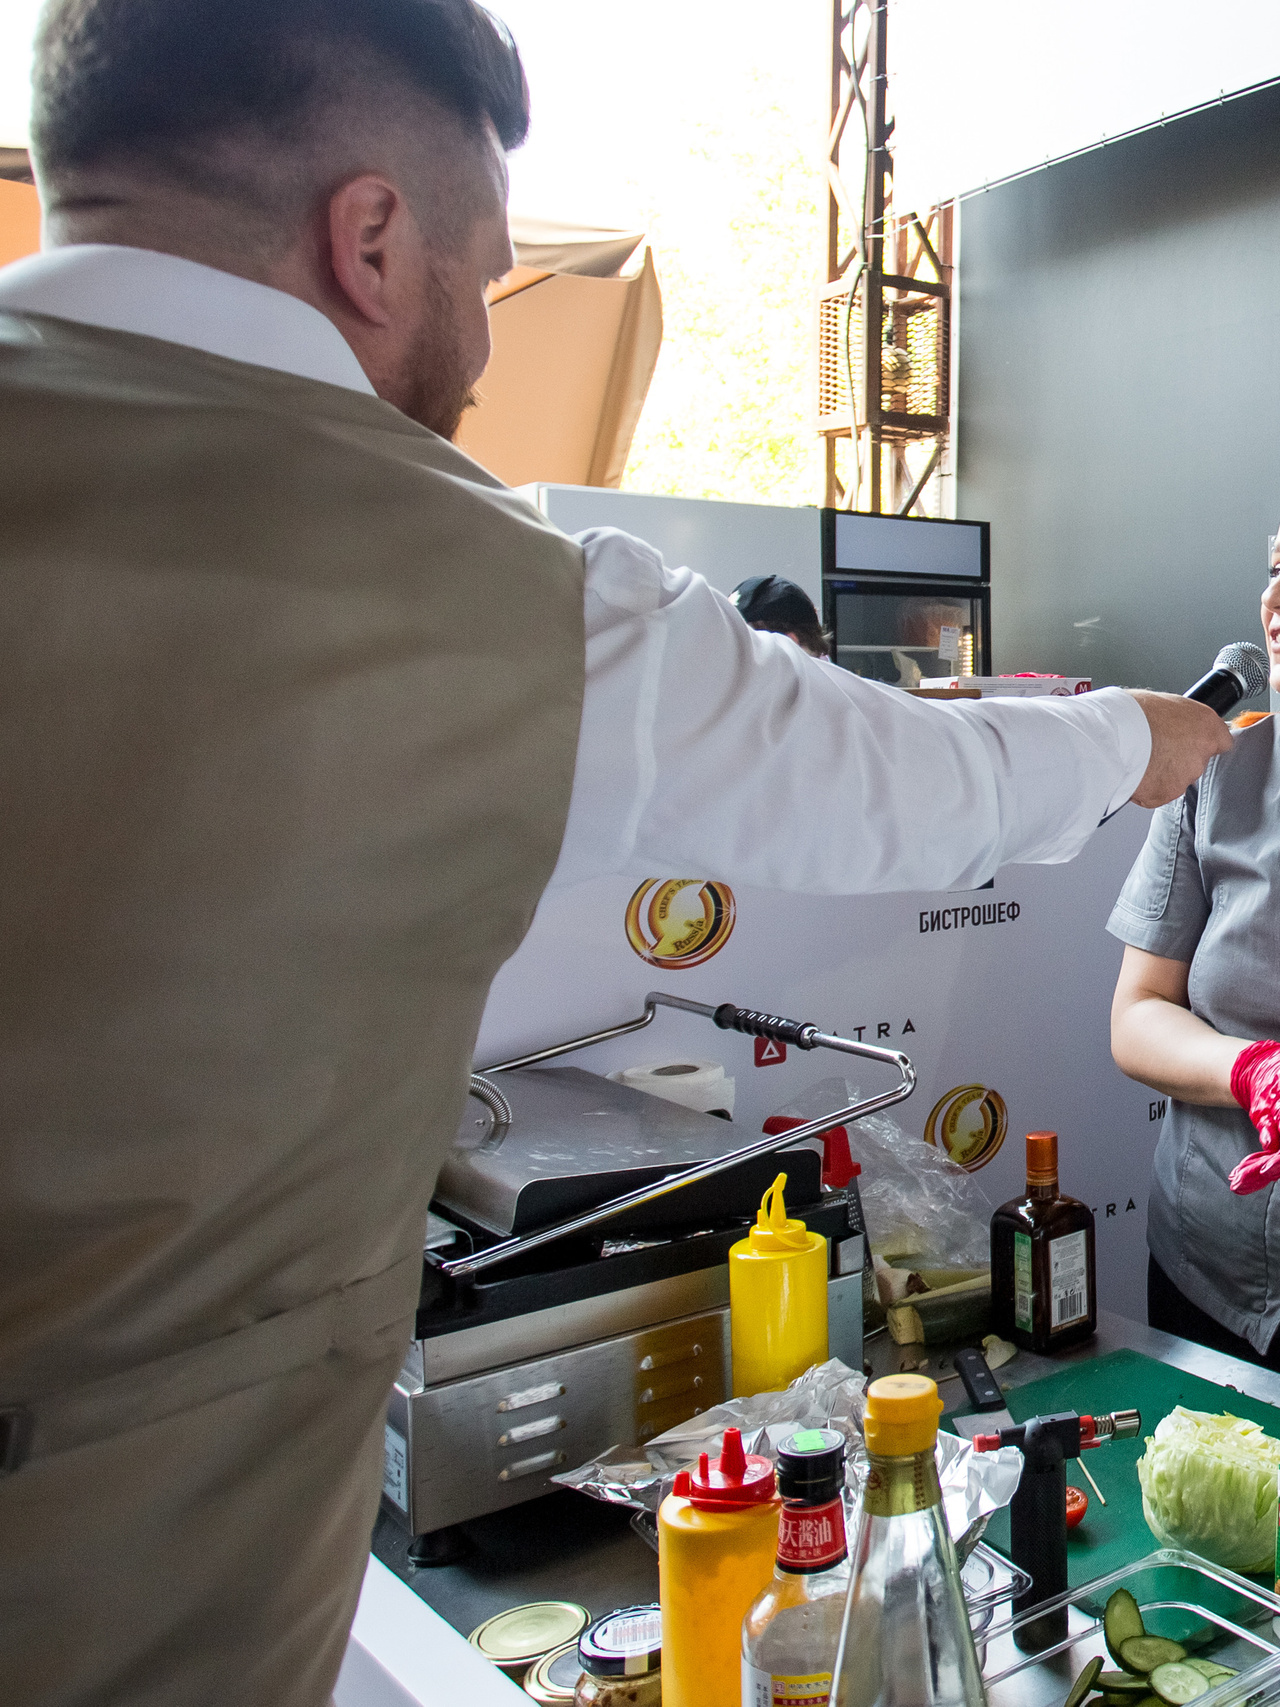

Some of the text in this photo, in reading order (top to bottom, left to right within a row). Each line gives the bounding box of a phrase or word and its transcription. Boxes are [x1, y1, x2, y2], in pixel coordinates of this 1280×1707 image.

[919, 901, 1021, 934] БИСТРОШЕФ
[673, 919, 705, 952] Russia
[832, 1018, 916, 1042] TRA
